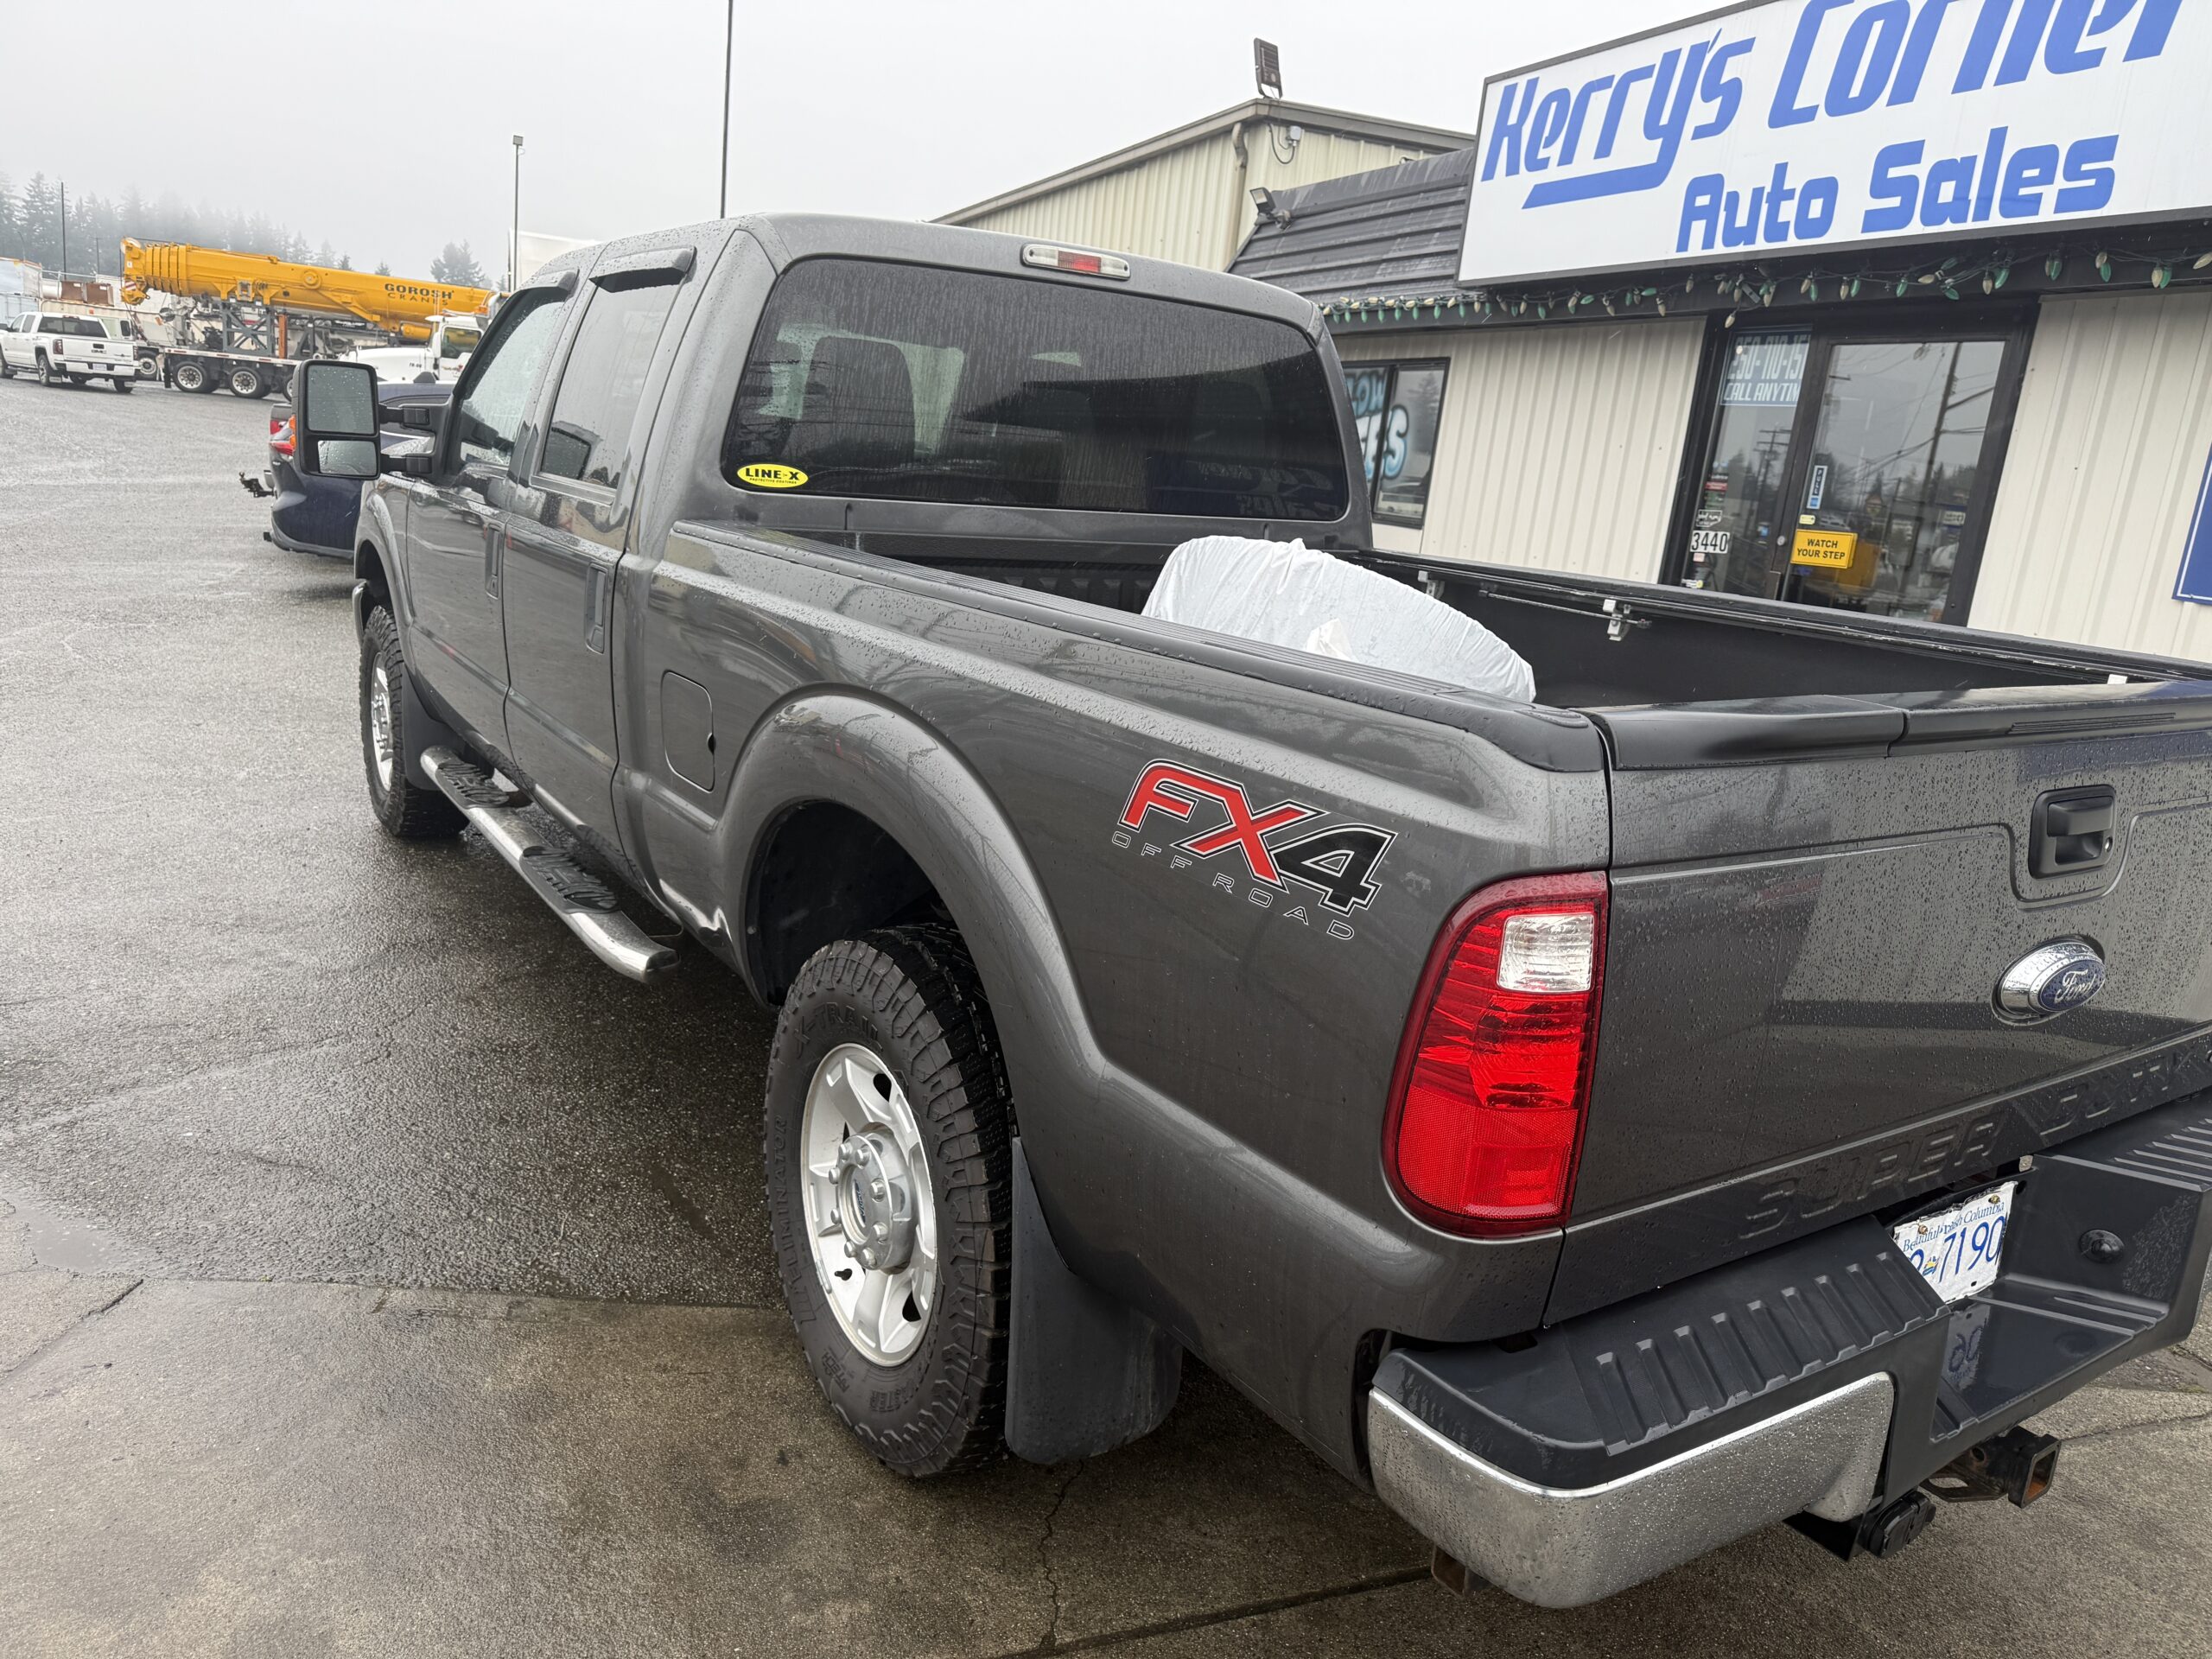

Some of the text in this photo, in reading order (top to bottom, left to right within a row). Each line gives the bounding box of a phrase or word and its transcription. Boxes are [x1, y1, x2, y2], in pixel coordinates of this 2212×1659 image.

[1481, 0, 2183, 209] Kerry's Corner
[1675, 126, 2120, 253] Auto Sales
[385, 283, 454, 300] GOROSH
[387, 292, 448, 305] CRANES
[1723, 382, 1752, 401] CALL
[746, 467, 800, 480] LINE-X
[1691, 532, 1728, 552] 3440
[1807, 538, 1839, 549] WATCH
[1796, 548, 1846, 560] YOUR STEP
[1116, 758, 1399, 918] FX4
[1111, 830, 1355, 940] OFF ROAD
[2054, 968, 2097, 1004] Ford
[1737, 1109, 2005, 1240] SUPER
